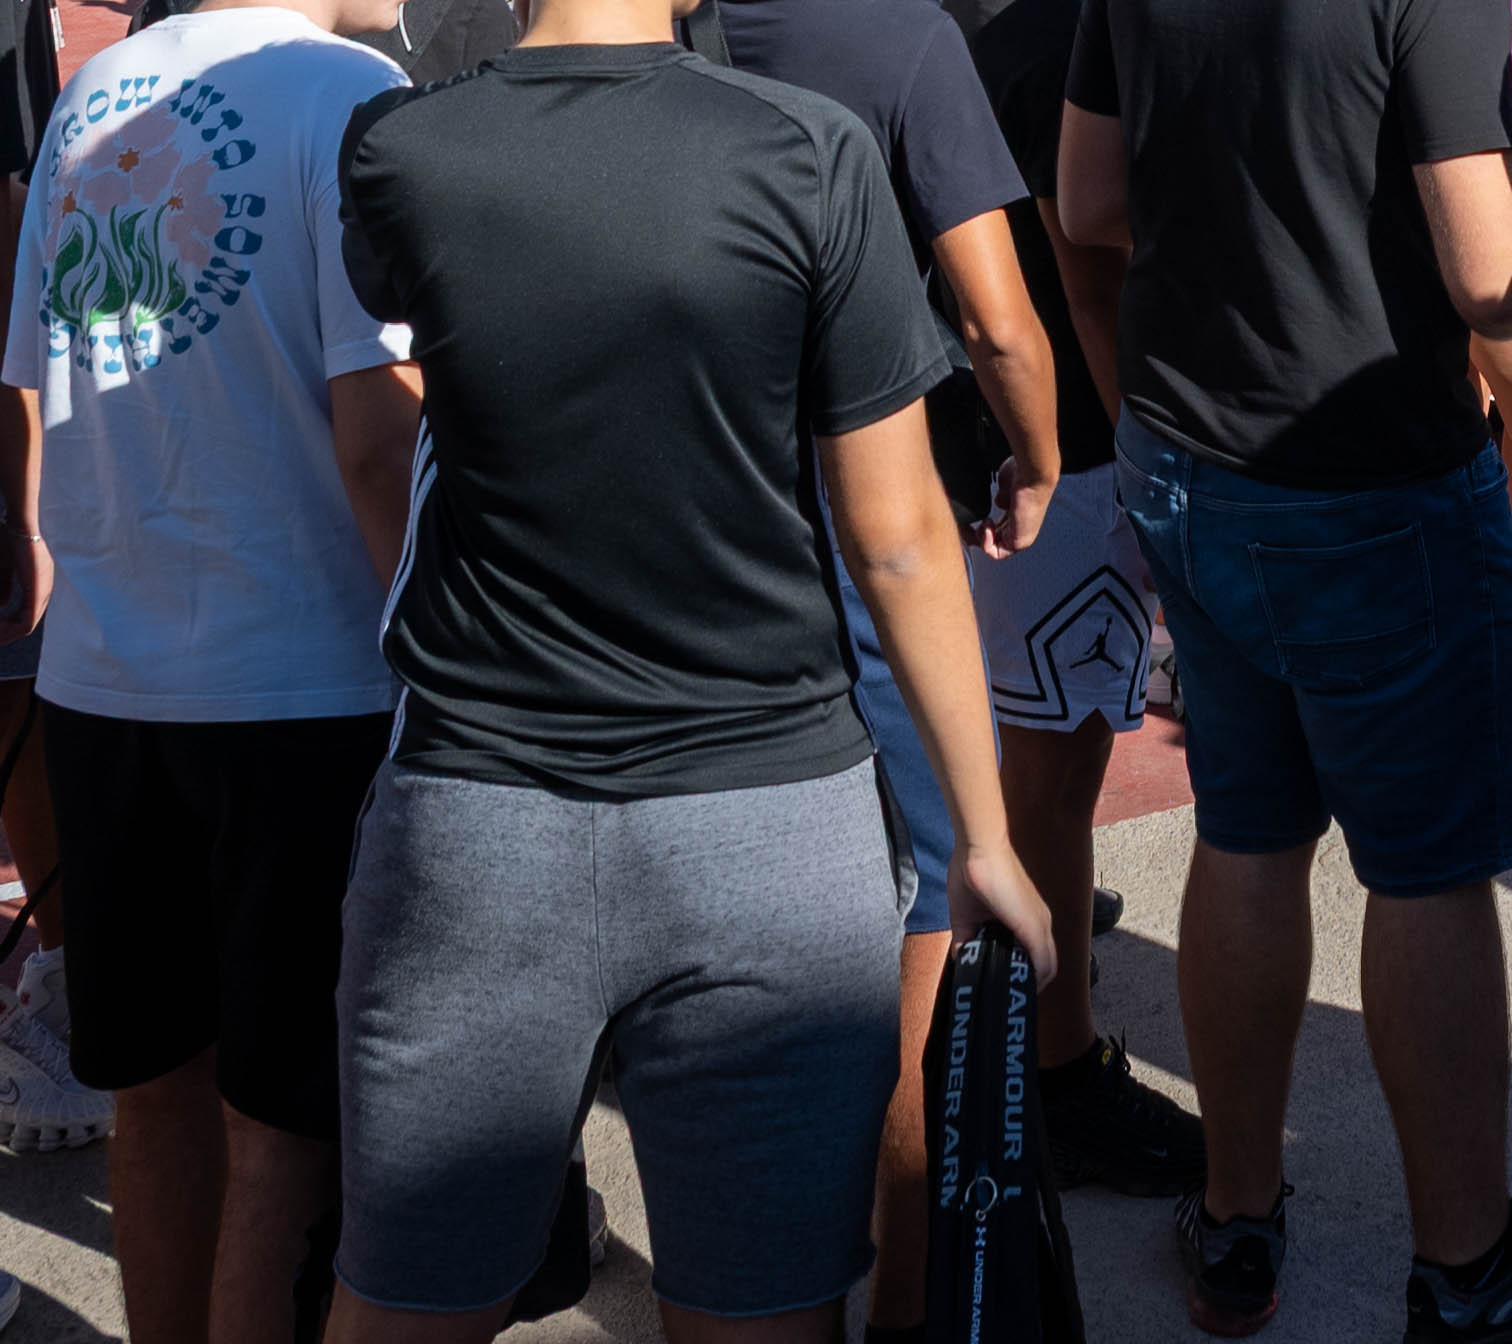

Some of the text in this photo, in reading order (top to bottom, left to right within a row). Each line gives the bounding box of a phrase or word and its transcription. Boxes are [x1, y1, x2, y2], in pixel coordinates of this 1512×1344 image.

[168, 78, 257, 170] INTO
[944, 985, 974, 1118] UNDER
[1003, 988, 1028, 1162] ARMOUR
[972, 1250, 985, 1305] UNDER
